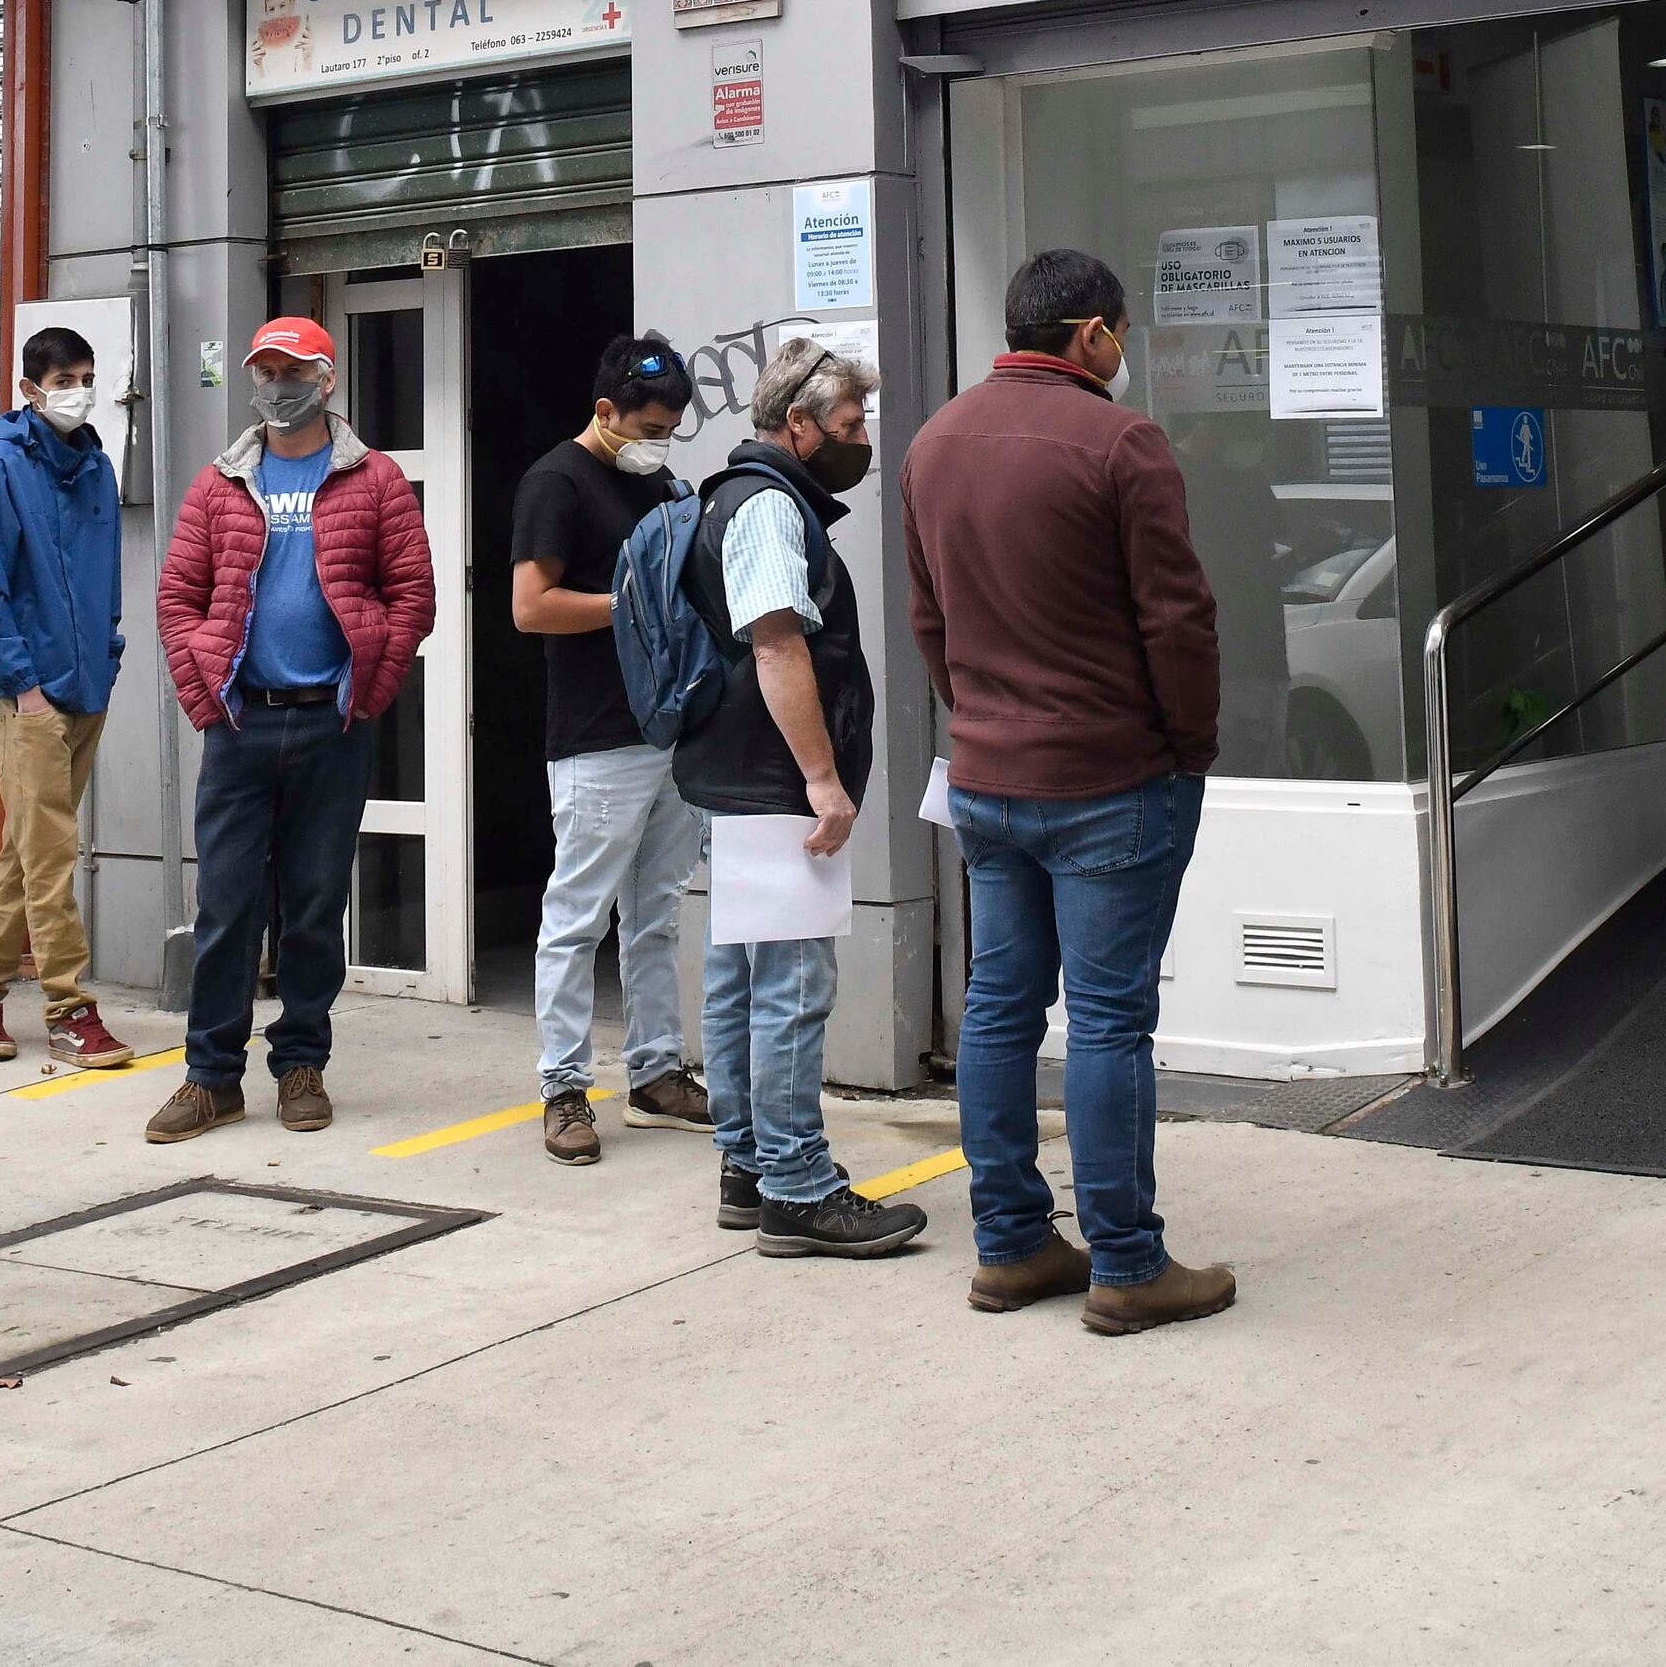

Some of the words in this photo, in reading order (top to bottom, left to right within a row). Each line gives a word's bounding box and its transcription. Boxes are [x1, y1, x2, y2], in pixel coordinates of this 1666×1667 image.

[321, 62, 350, 74] Lautaro
[352, 59, 367, 69] 177
[412, 50, 423, 61] of.
[424, 49, 430, 59] 2
[470, 37, 507, 51] Teléfono
[510, 35, 526, 46] 063
[535, 28, 572, 42] 2259424
[714, 62, 760, 76] verisure
[715, 86, 760, 101] Alarma
[804, 213, 859, 230] Atención
[1283, 238, 1315, 246] MAXIMO
[1323, 235, 1361, 244] USUARIOS
[1298, 250, 1308, 258] EN
[1309, 248, 1346, 257] ATENCION
[830, 259, 848, 268] jueves
[1161, 261, 1181, 270] USO
[1161, 270, 1232, 282] OBLIGATORIO
[807, 280, 829, 288] Viernes
[830, 279, 837, 287] de
[1161, 284, 1173, 293] DE
[1176, 280, 1250, 293] MASCARILLAS
[1229, 303, 1244, 312] AFC
[1582, 335, 1627, 380] AFC
[1215, 390, 1265, 403] SEGURO
[264, 491, 316, 514] WI
